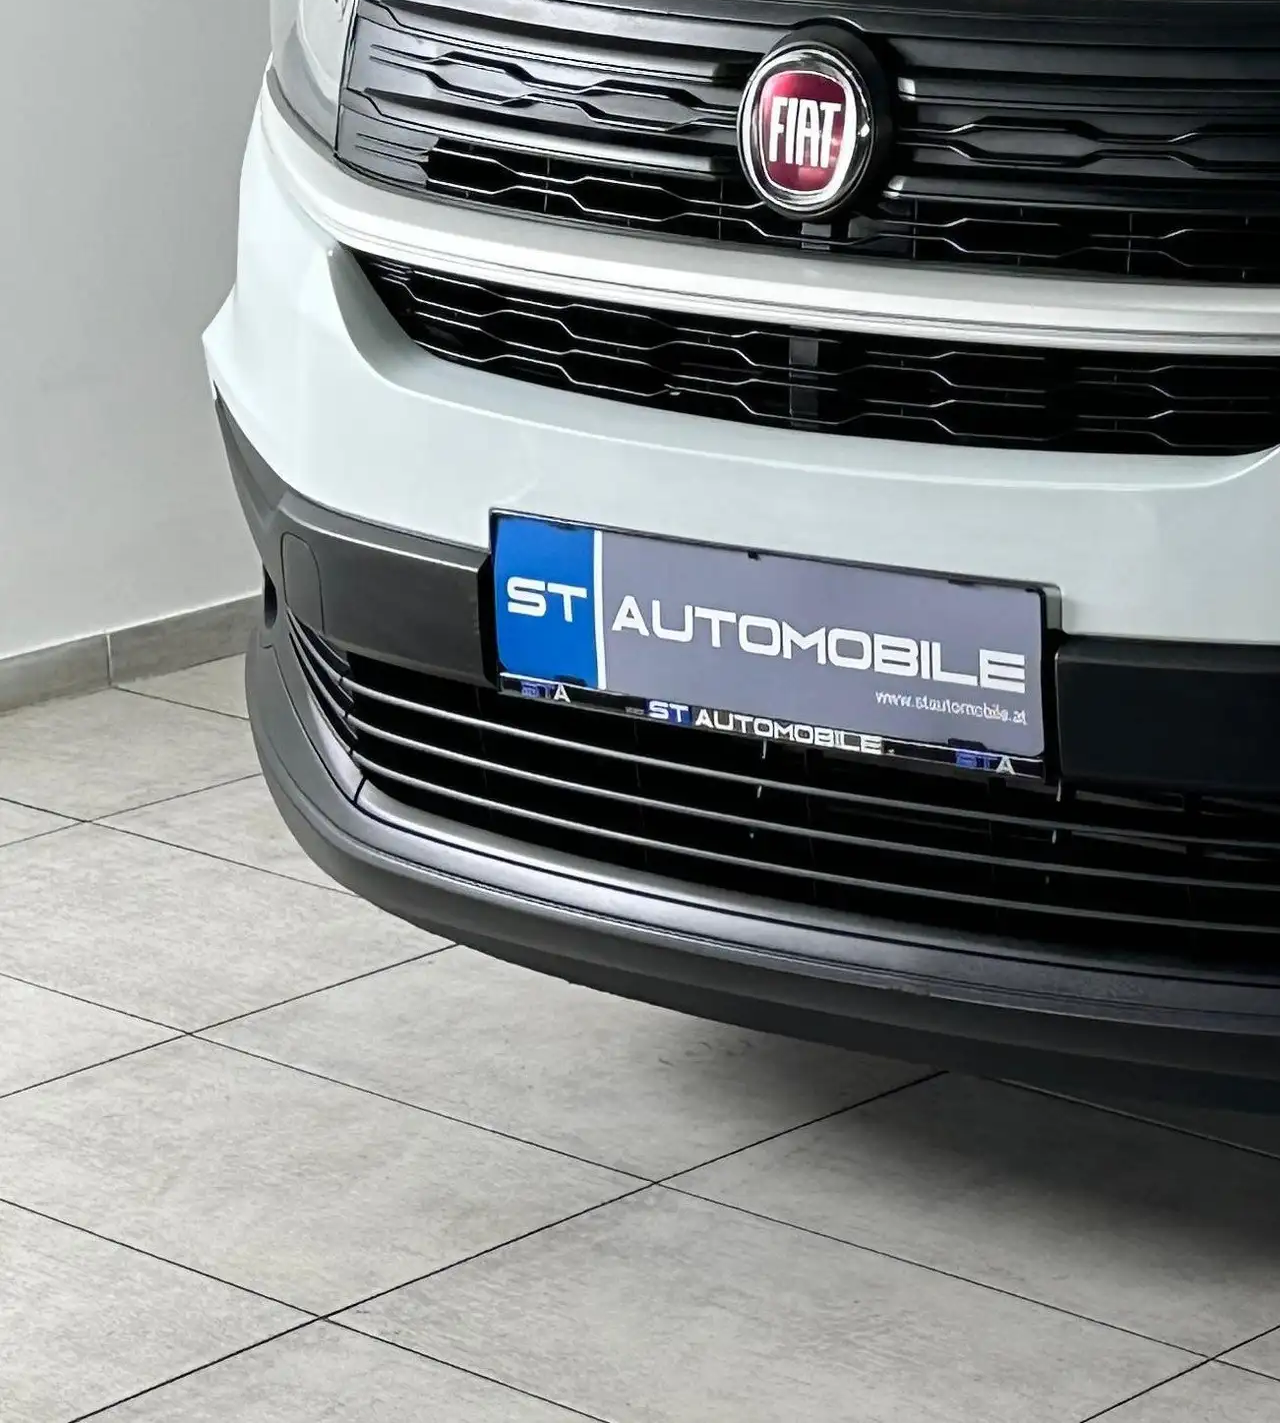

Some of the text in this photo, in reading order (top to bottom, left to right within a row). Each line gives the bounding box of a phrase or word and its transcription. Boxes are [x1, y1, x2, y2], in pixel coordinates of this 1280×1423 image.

[768, 96, 842, 168] FIAT
[506, 576, 1027, 694] ST AUTOMOBILE
[648, 700, 883, 755] ST AUTOMOBILE
